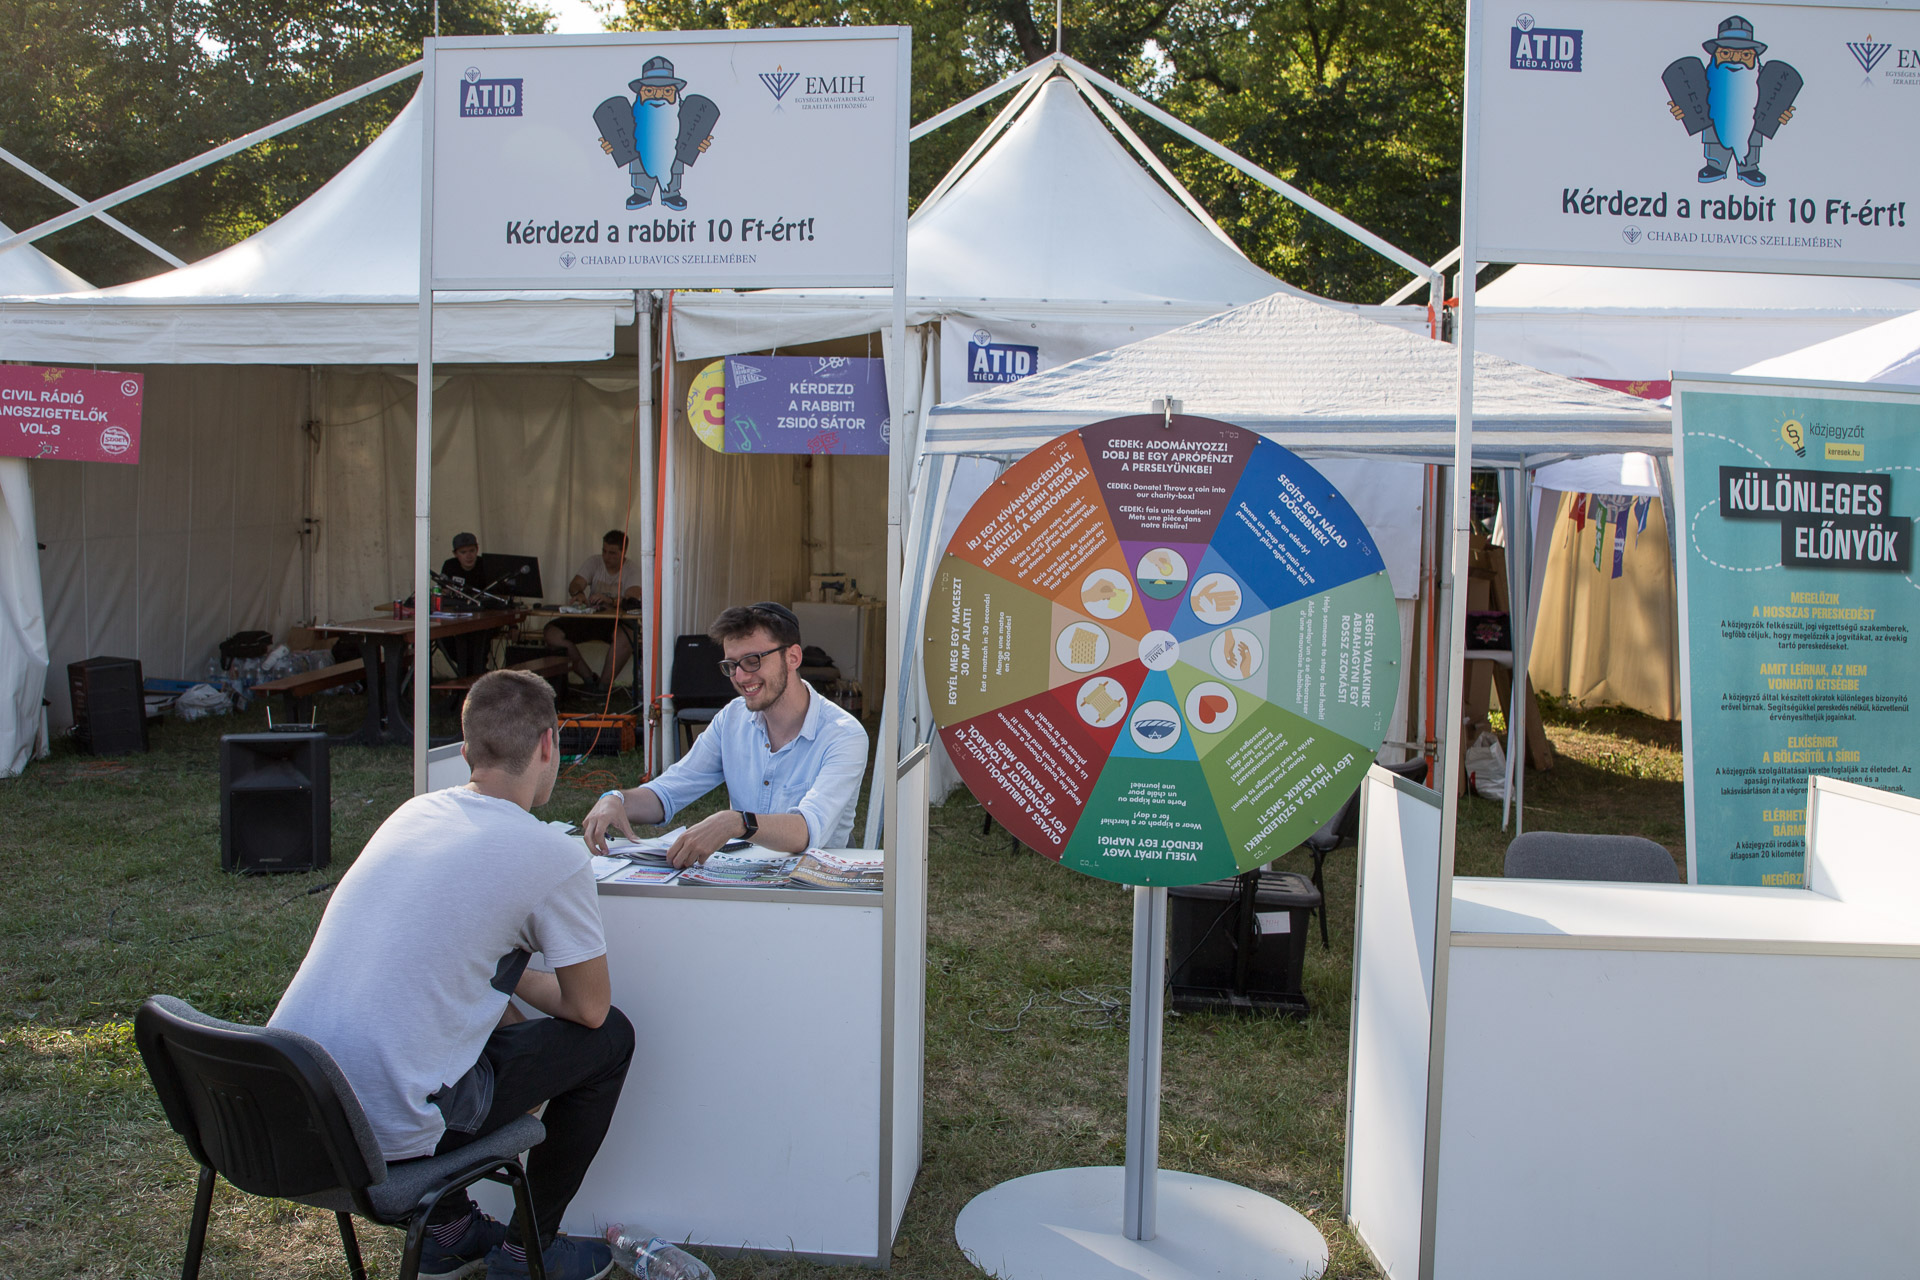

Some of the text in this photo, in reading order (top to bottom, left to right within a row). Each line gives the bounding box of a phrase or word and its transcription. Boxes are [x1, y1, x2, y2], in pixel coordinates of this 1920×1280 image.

[1516, 34, 1575, 61] ATID
[1517, 59, 1574, 70] TIÉD A JÖVŐ
[806, 76, 864, 94] EMIH
[465, 85, 516, 108] ATID
[465, 107, 484, 115] TIÉD
[495, 107, 515, 116] JÖVŐ
[1563, 188, 1905, 227] Kérdezd a rabbit 10 Ft-ért!
[507, 217, 814, 244] Kérdezd a rabbit 10 Ft-ért!
[1647, 231, 1842, 248] CHABAD LUBAVICS SZELLEMÉBEN
[581, 254, 756, 265] CHABAD LUBAVICS SZELLEMÉBEN
[974, 349, 1030, 375] ATID
[974, 373, 994, 381] TIÉD
[997, 373, 1004, 381] A
[790, 380, 854, 395] KÉRDEZD
[2, 389, 84, 404] CIVIL RÁDIÓ
[0, 405, 107, 422] NGSZIGETELŐK
[704, 387, 725, 425] 3
[788, 400, 855, 412] A RABBIT!
[20, 423, 61, 435] VOL.3
[777, 415, 865, 429] ZSIDÓ SÁTOR
[1809, 423, 1864, 440] közjegyzőt
[1108, 439, 1228, 451] CEDEK: ADOMÁNYOZZ!
[1828, 448, 1861, 457] keresek.hu
[1102, 450, 1233, 463] DOBJ BE EGY APRÓPÉNZT
[1121, 462, 1212, 474] A PERSELYÜNKBE!
[1107, 482, 1132, 490] CEDEK:
[1133, 483, 1162, 491] Donate!
[1163, 484, 1187, 492] Throw
[1195, 485, 1210, 493] coin
[1151, 491, 1195, 500] charity-box!
[1730, 473, 1882, 515] KÜLÖNLEGES
[966, 452, 1074, 551] ÍRJ EGY KÍVÁNSÁGCÉDULÁT,
[983, 467, 1073, 551] KVITLIT, AZ EMIH PEDIG
[983, 468, 1089, 567] ELHELYEZI A SIRATÓFALNÁL!
[1277, 474, 1347, 548] SEGÍTS EGY NÁLAD
[1279, 492, 1329, 546] IDŐSEBBNEK!
[1268, 509, 1311, 555] Help an elderly!
[1796, 521, 1897, 561] ELŐNYÖK
[1752, 605, 1875, 620] A HOSSZAS PERESKEDÉST
[982, 625, 989, 636] 30
[1720, 620, 1726, 628] A
[1805, 622, 1817, 633] jogi
[947, 578, 962, 705] EGYÉL MEG EGY MACESZT
[960, 608, 972, 676] 30 MP ALATT!
[1778, 641, 1849, 650] tartó pereskedéseket.
[1148, 648, 1164, 664] EMIH
[1338, 615, 1350, 703] ROSSZ SZOKÁST!
[1350, 613, 1362, 707] ABBAHAGYNI EGY
[1361, 613, 1376, 707] SEGÍTS VALAKINEK
[1760, 663, 1867, 676] AMIT LEÍRNAK, AZ NEM
[1768, 677, 1859, 691] VONHATÓ KÉTSÉGBE
[1788, 736, 1838, 748] ELKÍSÉRNEK
[1762, 751, 1770, 763] A
[1827, 751, 1833, 762] A
[1835, 749, 1860, 762] SÍRIG
[968, 725, 1067, 834] EGY MONDATOT A TÓRÁBÓL
[995, 739, 1056, 805] ÉS TANULD MEG!
[955, 728, 1061, 845] OLVASS A BIBLIÁBÓL! HÚZZ KI
[1257, 763, 1326, 825] ÍRJ NEKIK SMS-T!
[1244, 753, 1354, 851] LÉGY HÁLÁS A SZÜLEIDNEK!
[1098, 836, 1203, 851] KENDŐT EGY NAPIG!
[1103, 848, 1197, 861] VISELJ KIPÁT VAGY
